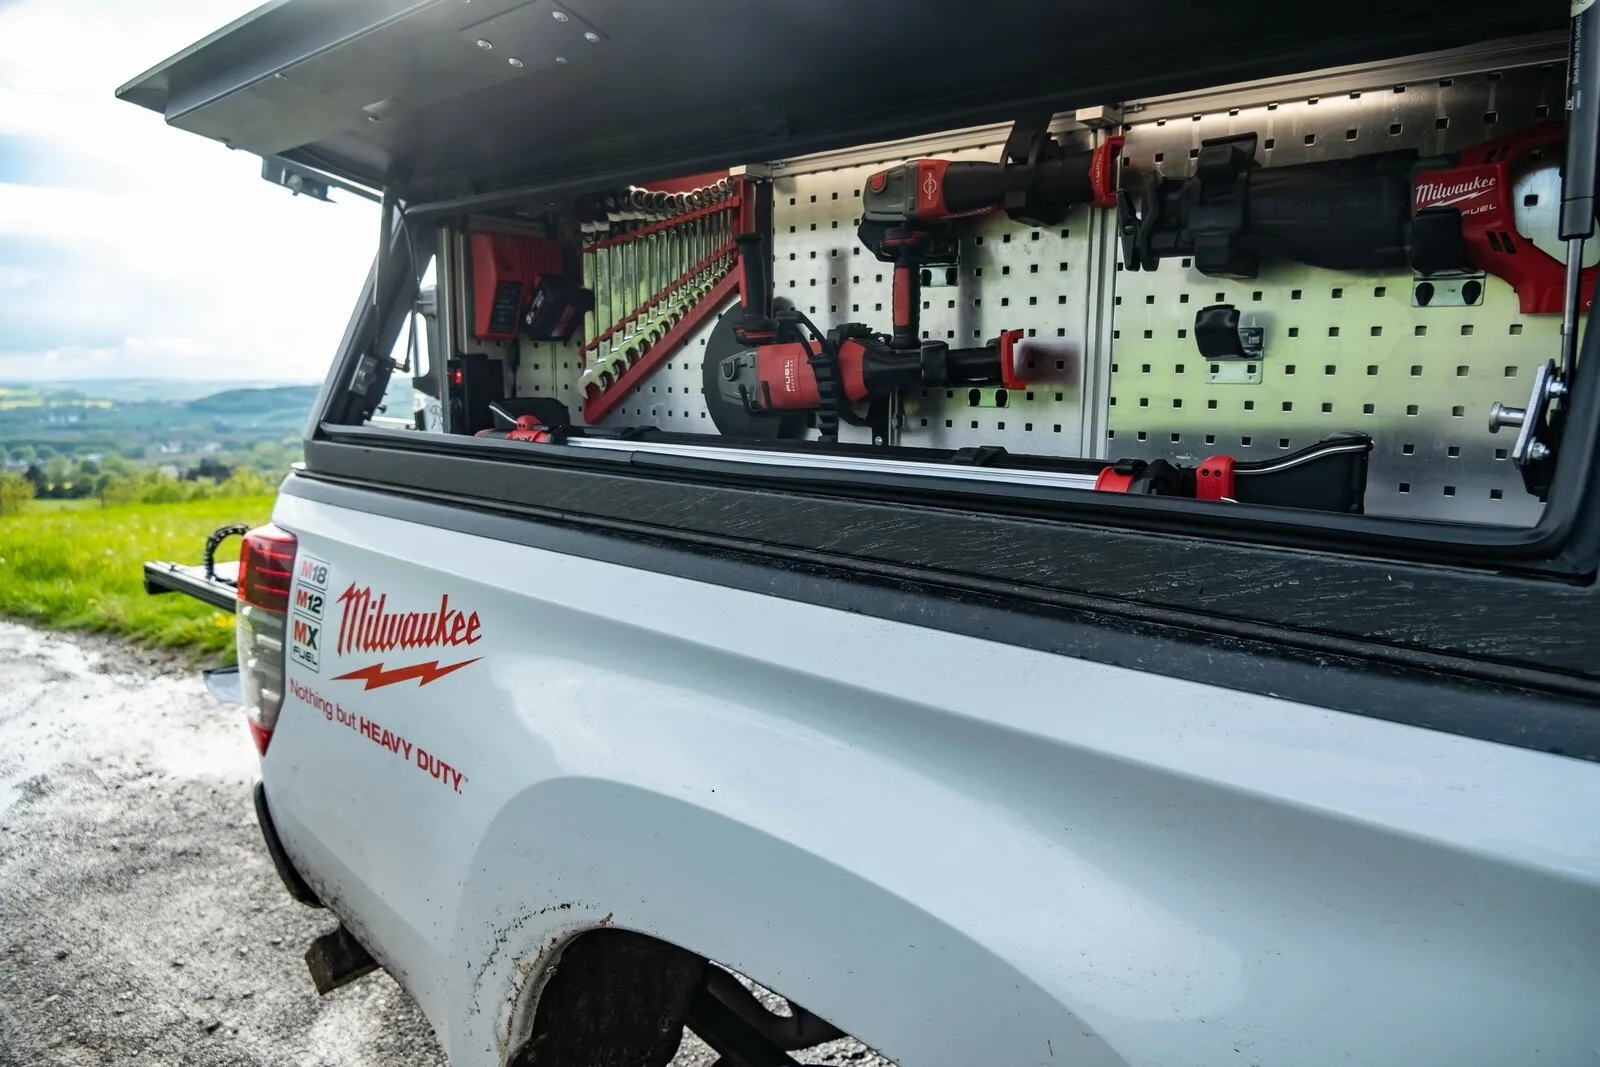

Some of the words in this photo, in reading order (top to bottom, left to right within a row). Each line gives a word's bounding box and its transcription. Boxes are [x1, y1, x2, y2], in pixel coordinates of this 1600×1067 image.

[1416, 176, 1496, 204] Milwaukee
[1461, 204, 1497, 217] FUEL
[784, 360, 792, 392] FUEL
[301, 559, 328, 584] M18
[296, 589, 323, 614] M12
[336, 580, 482, 657] Milwaukee
[293, 619, 319, 650] MX
[293, 645, 318, 666] FUEL
[290, 677, 333, 721] Nothing
[336, 702, 357, 731] but
[360, 716, 413, 760] HEAVY
